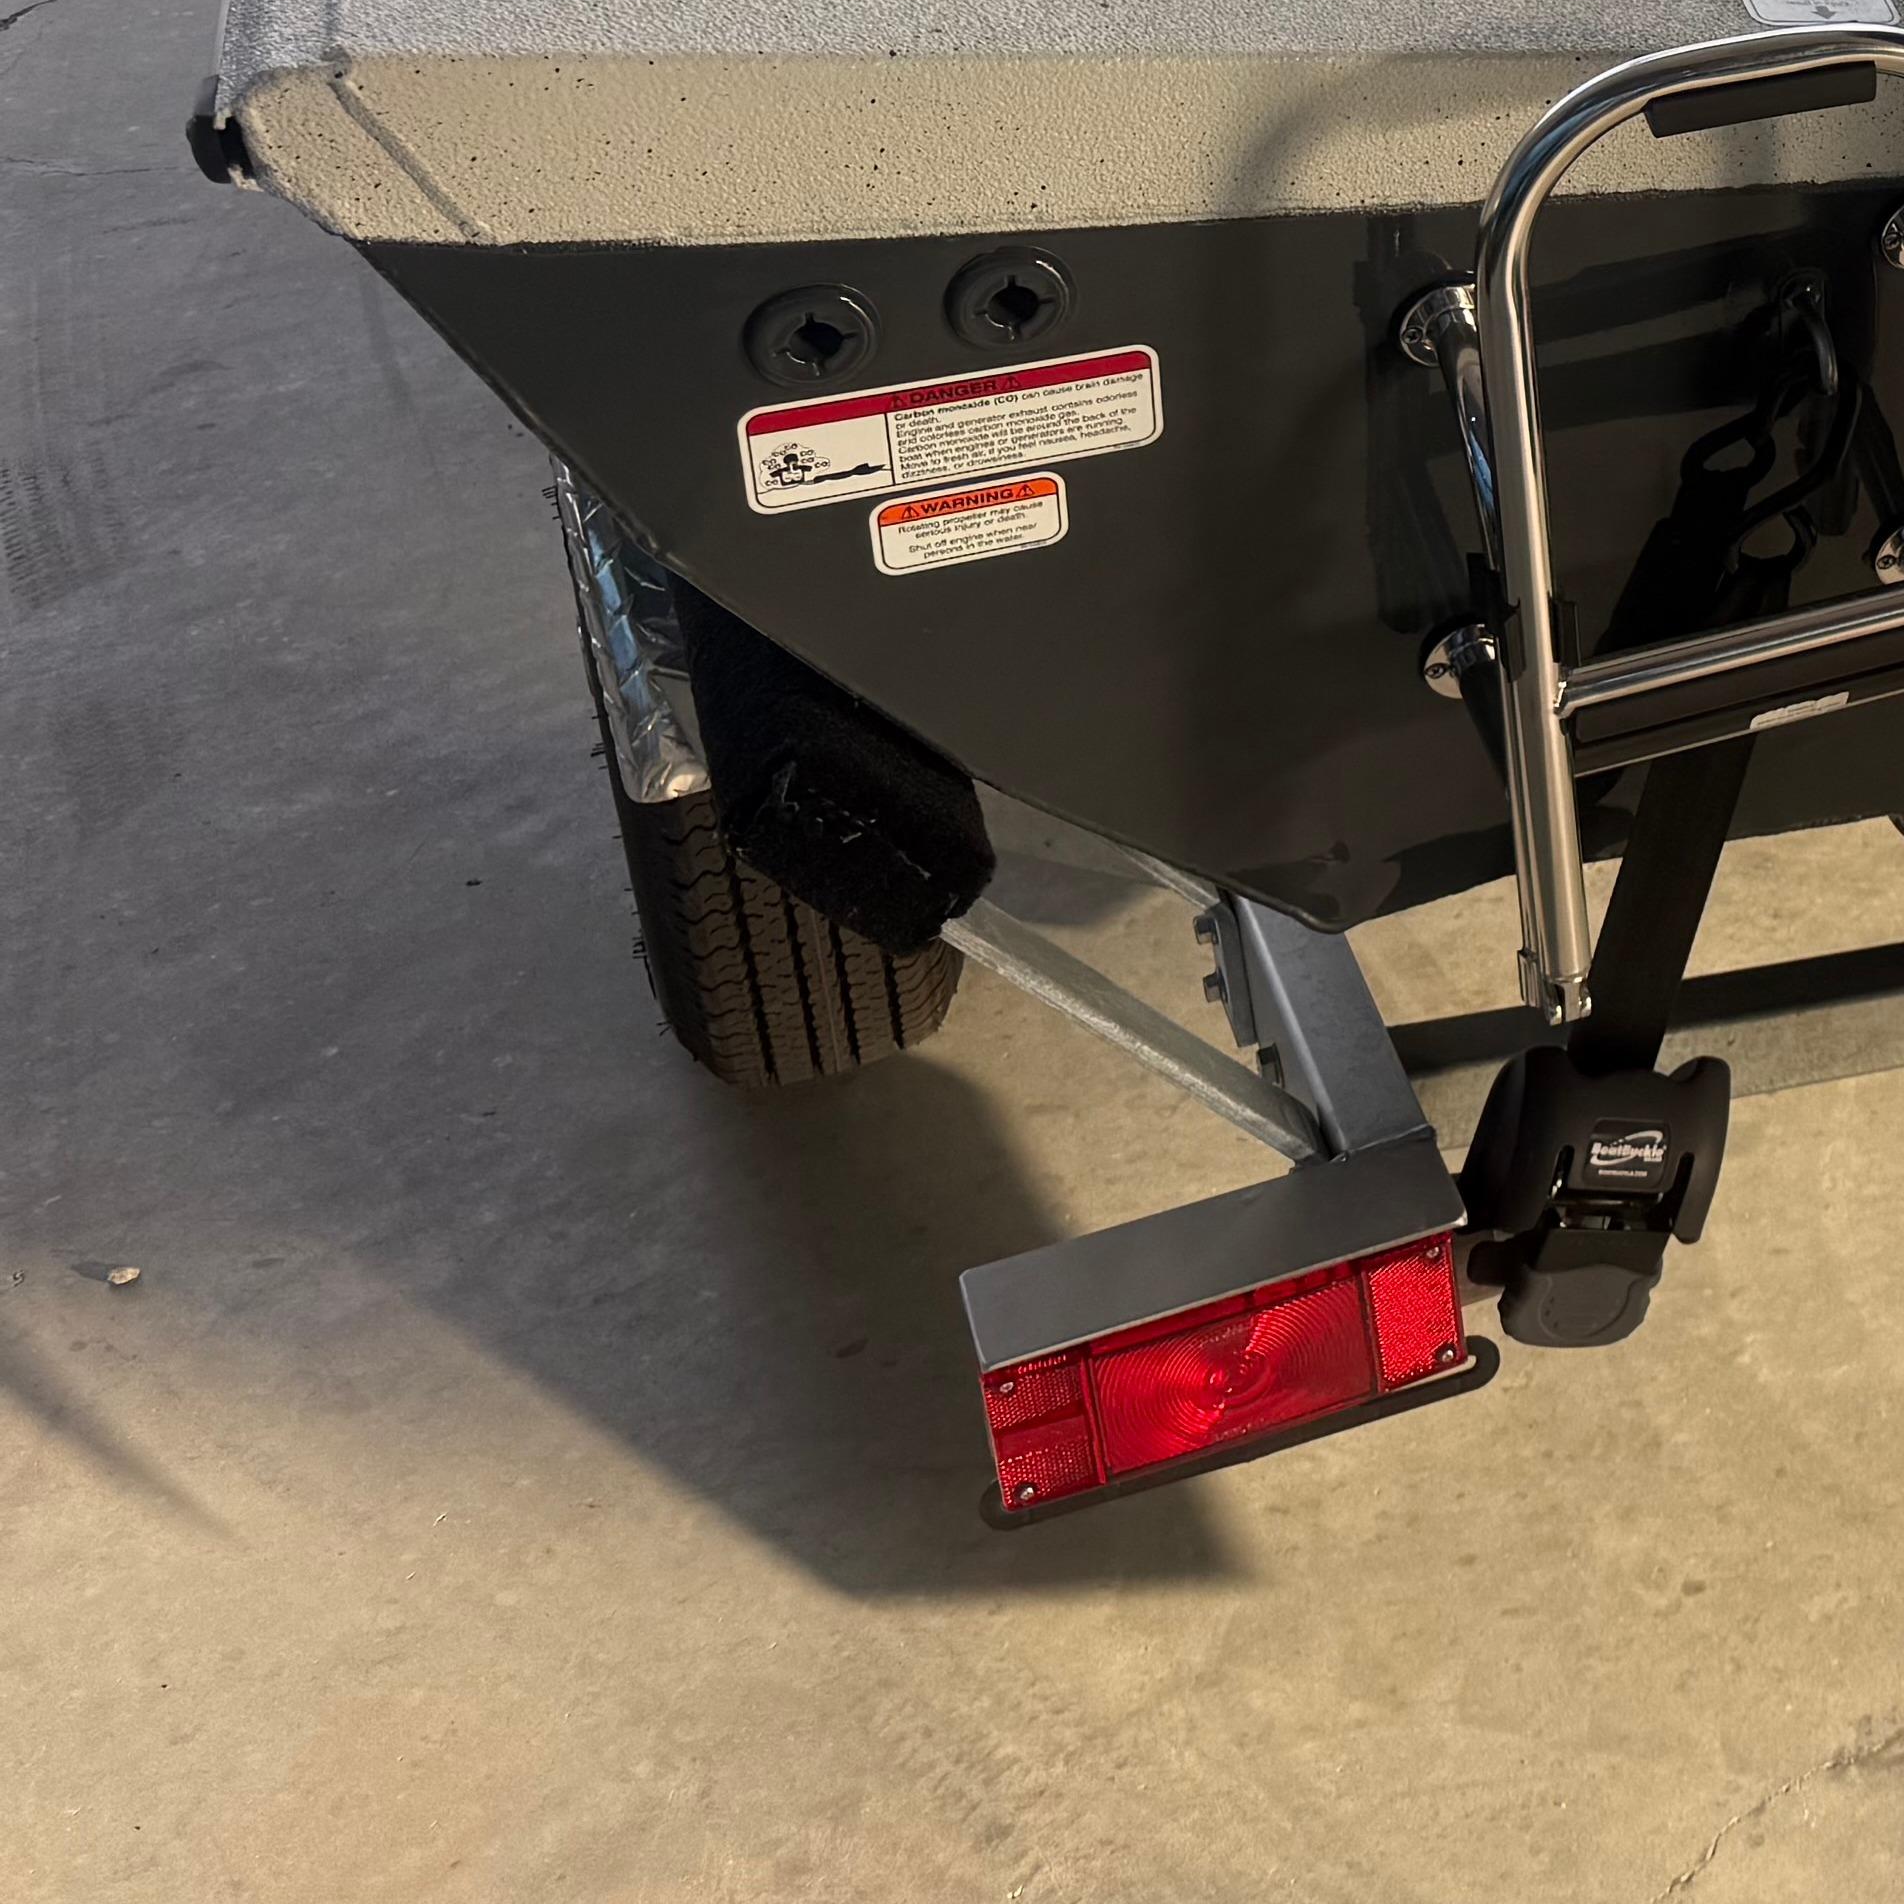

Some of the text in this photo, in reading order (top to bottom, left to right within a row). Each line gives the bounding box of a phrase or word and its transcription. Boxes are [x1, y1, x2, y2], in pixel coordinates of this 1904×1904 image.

[894, 407, 934, 421] Carbon
[938, 398, 989, 414] monoxide
[994, 393, 1018, 406] (CO)
[1043, 385, 1072, 396] cause
[1075, 379, 1099, 390] brain
[1102, 372, 1142, 387] damage
[910, 379, 996, 404] DANGER
[897, 389, 1137, 438] Engine and generator exhaust contains odorless
[967, 421, 1003, 434] carbon
[1006, 412, 1055, 427] monoxide
[898, 440, 936, 454] Carbon
[939, 431, 988, 447] monoxide
[1026, 419, 1061, 432] around
[1064, 416, 1078, 425] the
[1082, 411, 1105, 422] back
[1109, 408, 1118, 417] of
[1121, 406, 1136, 415] the
[925, 446, 952, 458] when
[955, 439, 995, 454] engines
[1010, 427, 1064, 444] generators
[943, 451, 968, 463] fresh
[997, 444, 1015, 455] you
[1018, 439, 1036, 450] feel
[921, 489, 1014, 514] WARNING
[898, 500, 1042, 534] Rotating propeller may cause
[915, 525, 951, 538] serious
[954, 520, 981, 532] injury
[984, 517, 993, 525] or
[934, 538, 946, 547] off
[949, 532, 983, 546] engine
[986, 526, 1012, 537] when
[1015, 522, 1036, 532] near
[977, 538, 993, 547] the
